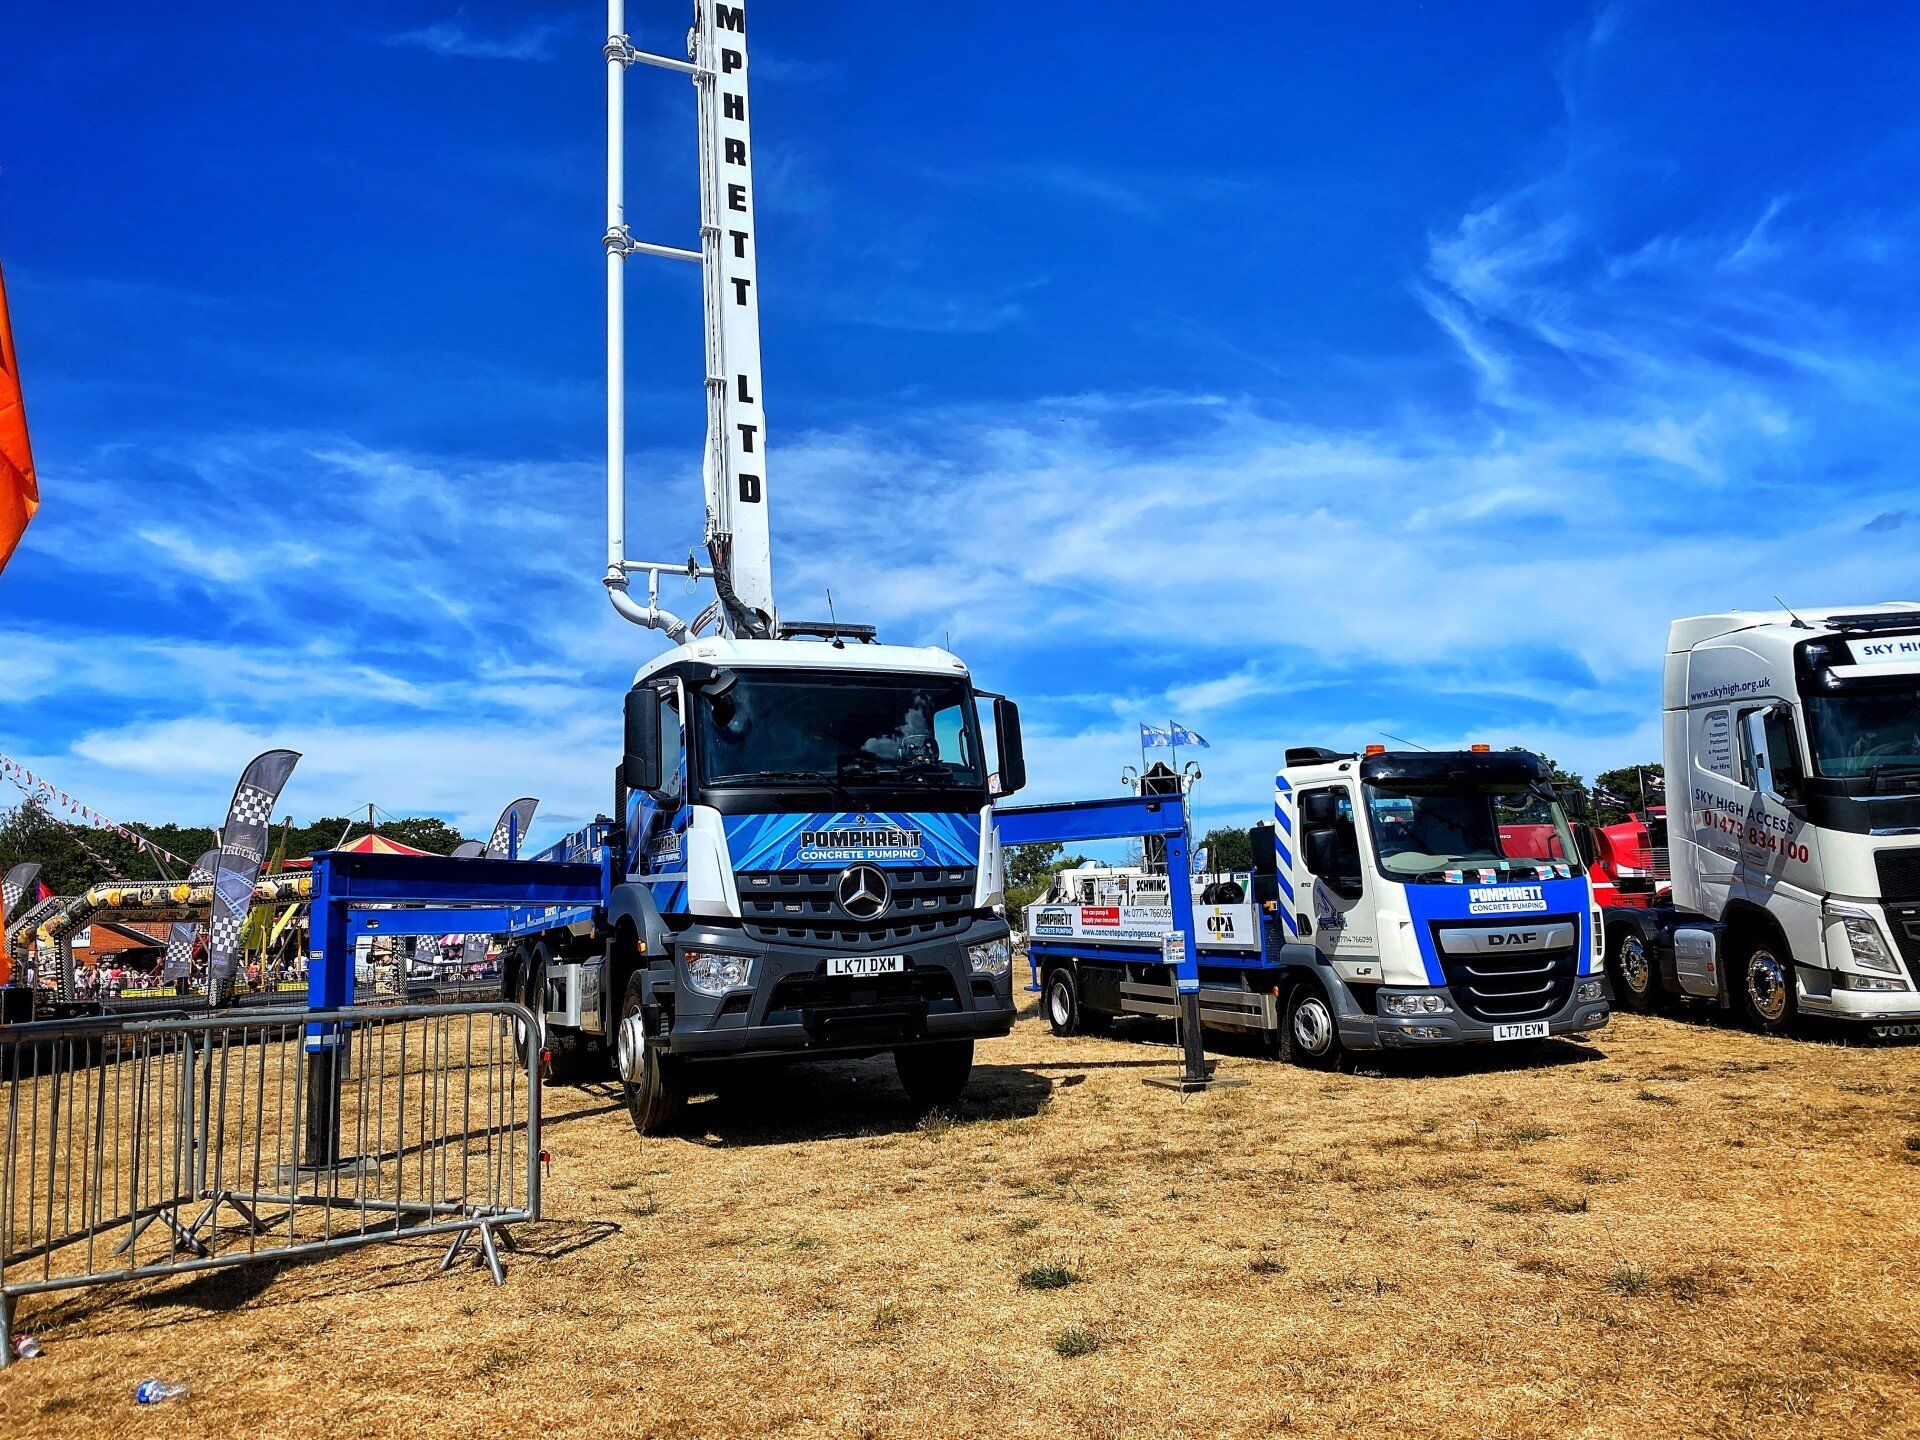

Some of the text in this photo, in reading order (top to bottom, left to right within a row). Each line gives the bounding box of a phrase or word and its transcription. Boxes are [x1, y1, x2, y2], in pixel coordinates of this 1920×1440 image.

[737, 374, 761, 503] LTD
[1863, 642, 1920, 655] SKY HI
[1690, 677, 1770, 701] www.skyhigh.org.uk
[1695, 788, 1794, 834] SKY HIGH ACCESS
[801, 830, 922, 848] POMPHRETT
[1704, 809, 1809, 863] 01473 834100
[221, 844, 262, 863] TRUCKS
[801, 849, 918, 860] CONCRETE PUMPING
[1136, 879, 1167, 892] SCHWING
[141, 892, 152, 900] 66
[1469, 886, 1542, 902] POMPHRETT
[1123, 908, 1171, 918] M: 07714 766099
[1472, 901, 1543, 912] CONCRETE PUMPING
[1036, 913, 1072, 925] POMPHRETT
[1206, 916, 1234, 931] CPA
[1082, 928, 1163, 939] www.concretepumpingessex.c
[1488, 932, 1536, 946] DAF
[835, 957, 896, 973] LK71 DXM
[1500, 1023, 1543, 1038] LT71 EYM
